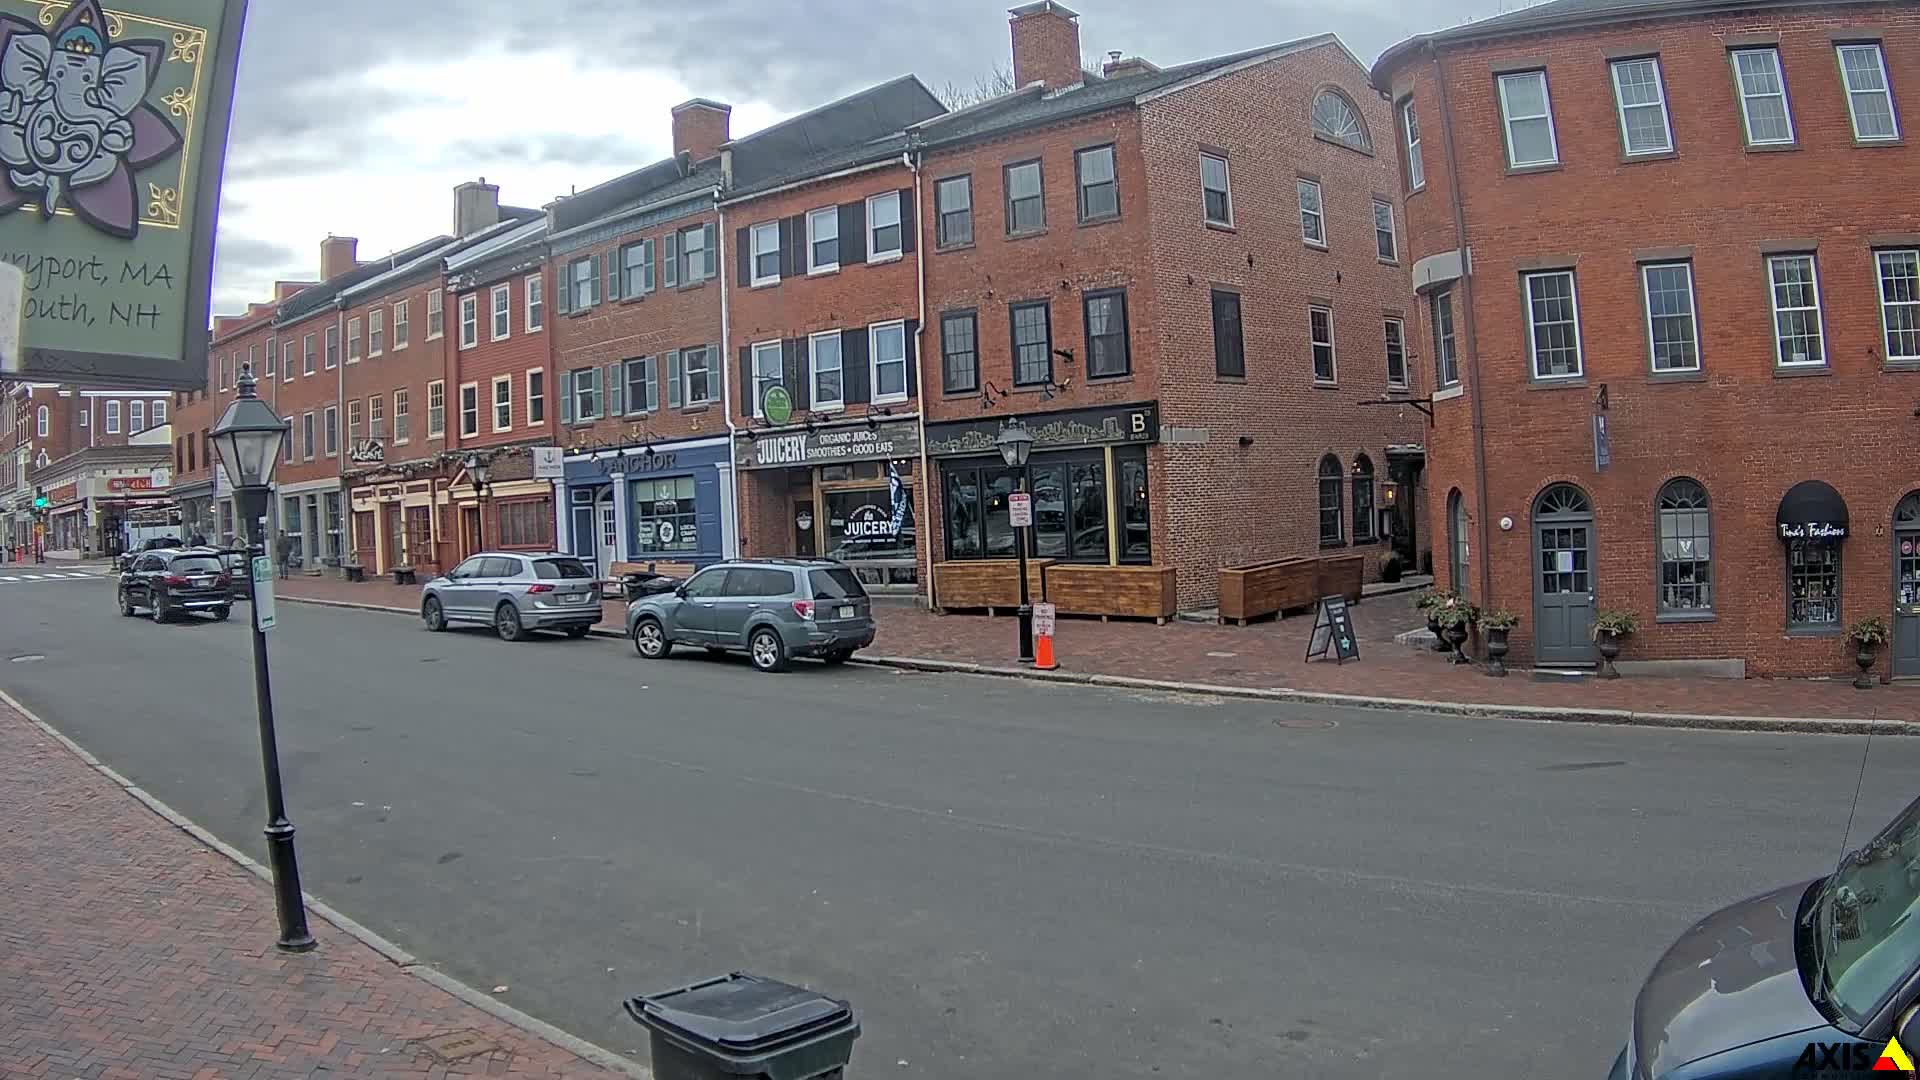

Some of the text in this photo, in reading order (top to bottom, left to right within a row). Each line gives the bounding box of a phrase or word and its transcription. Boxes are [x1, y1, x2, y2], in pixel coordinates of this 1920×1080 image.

[0, 253, 173, 291] ryport, MA
[110, 301, 160, 329] NH
[1131, 413, 1145, 433] B
[819, 430, 878, 445] ORGANIC JUICES
[757, 435, 806, 464] JUICERY
[807, 442, 894, 458] SMOOTHIES GOOD EATS
[844, 520, 892, 536] JUICERY
[1781, 522, 1845, 537] Tina's Fashions
